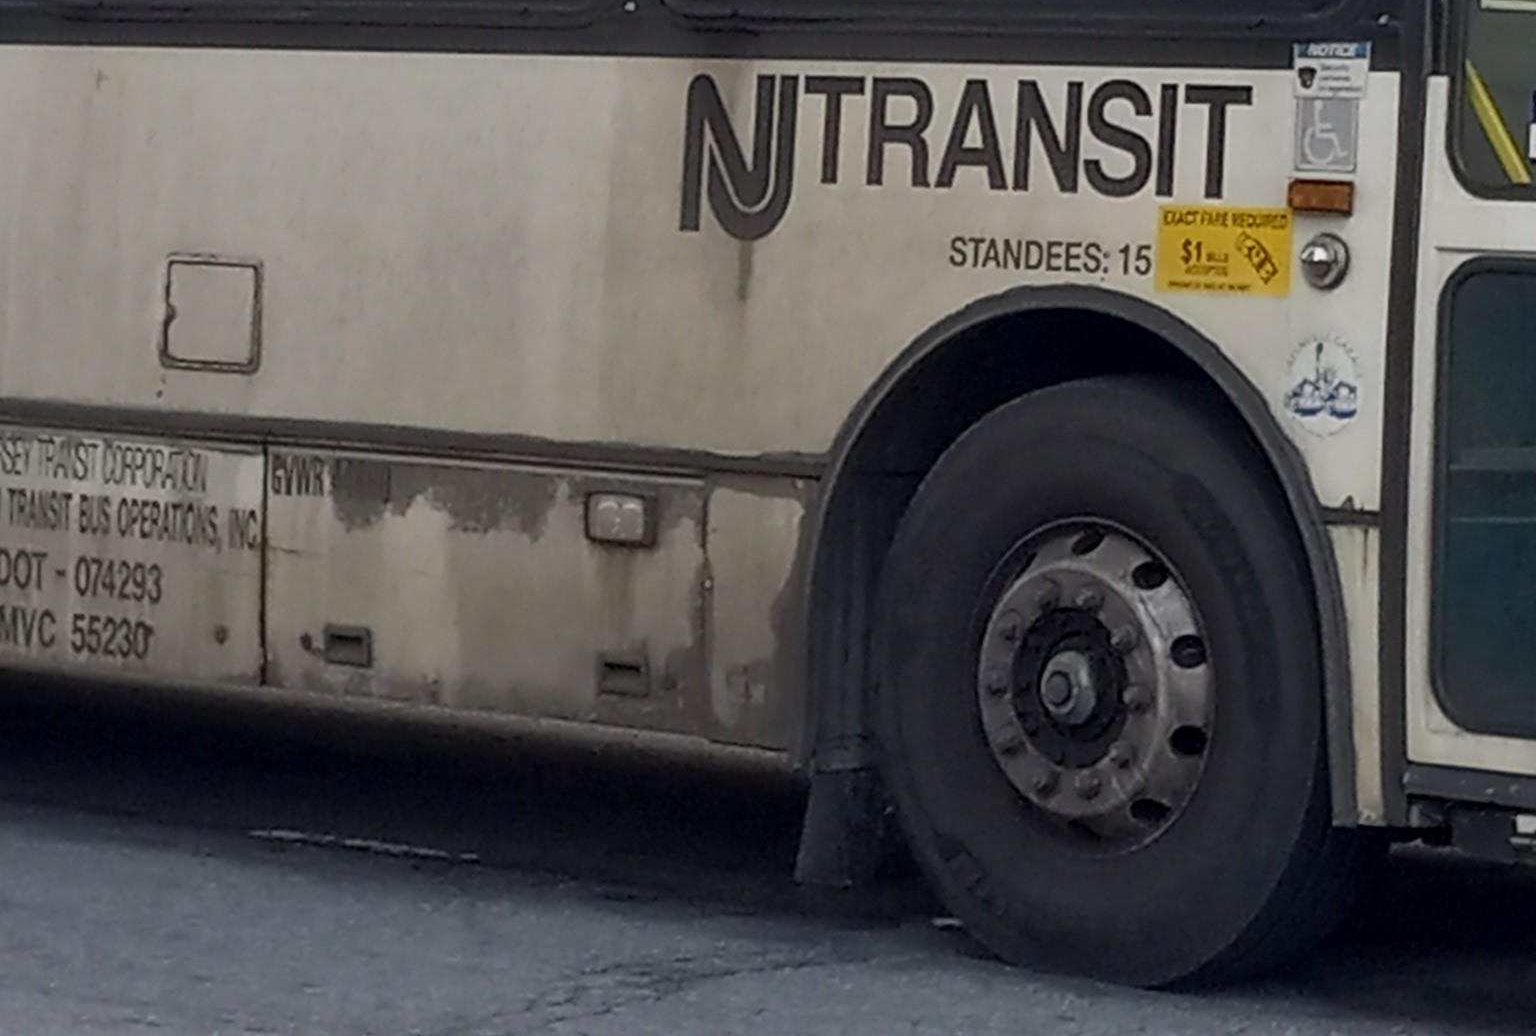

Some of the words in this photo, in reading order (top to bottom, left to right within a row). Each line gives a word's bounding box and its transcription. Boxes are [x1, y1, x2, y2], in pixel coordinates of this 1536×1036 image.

[1307, 43, 1357, 57] NOTICE
[680, 72, 800, 242] NJ
[804, 75, 1253, 200] TRANSIT
[949, 236, 1110, 275] STANDEES:
[1119, 244, 1152, 275] 15
[1181, 238, 1202, 264] $1
[271, 454, 324, 496] GVWR
[7, 489, 73, 533] TRANSIT
[79, 495, 112, 536] BUS
[75, 556, 162, 605] 074293
[71, 612, 154, 658] 55230
